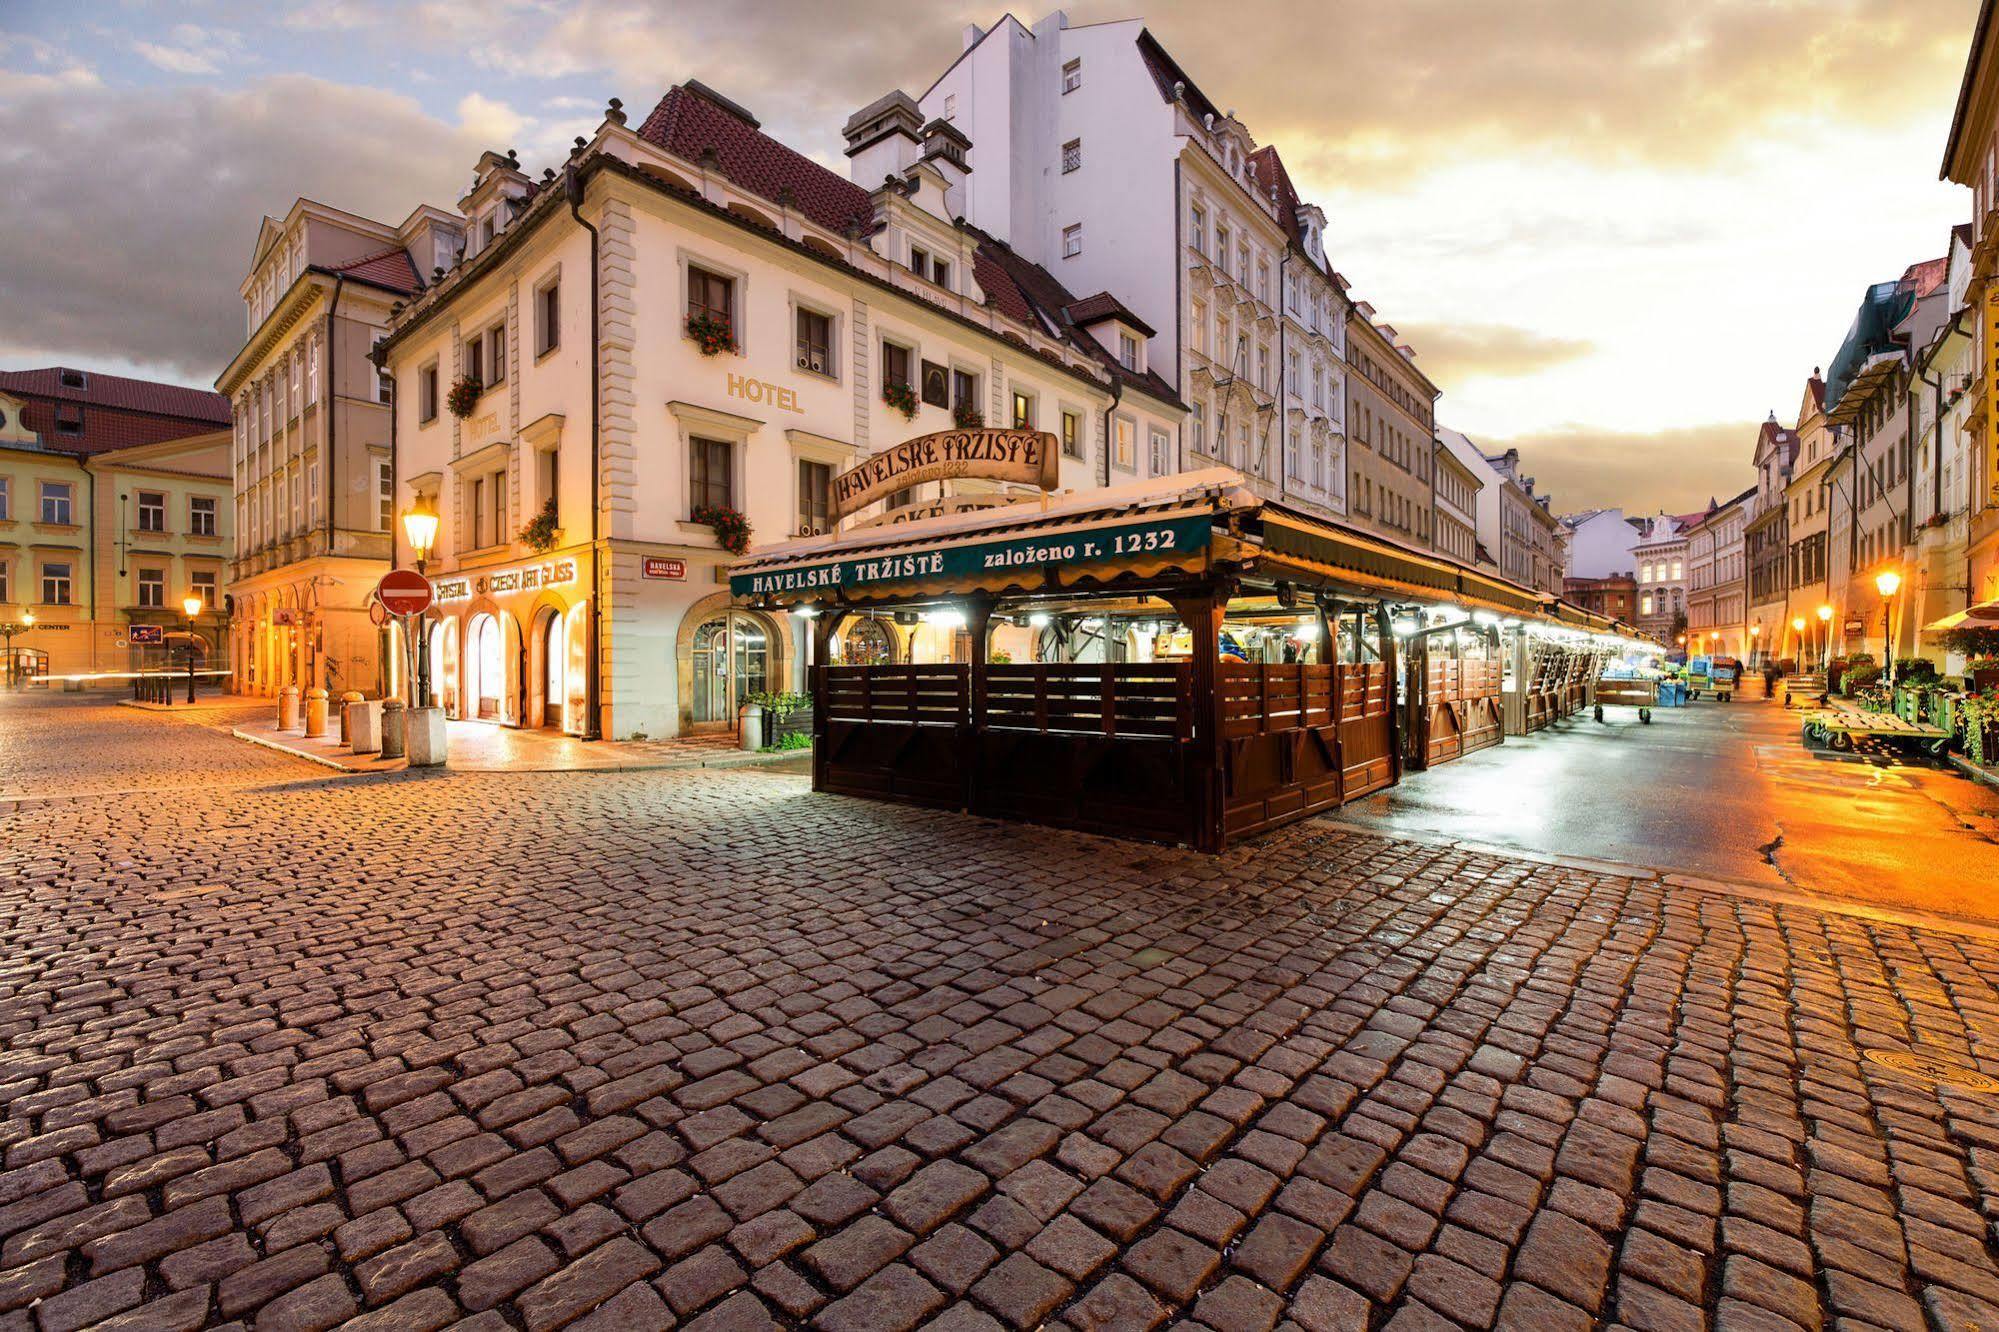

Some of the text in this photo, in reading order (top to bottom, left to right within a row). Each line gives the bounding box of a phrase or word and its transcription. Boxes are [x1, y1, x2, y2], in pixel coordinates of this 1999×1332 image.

[727, 372, 805, 414] HOTEL
[489, 561, 575, 593] CZECH ART GLASS
[752, 529, 1176, 593] HAVELSKÉ TRŽIŠTĚ založeno r. 1232
